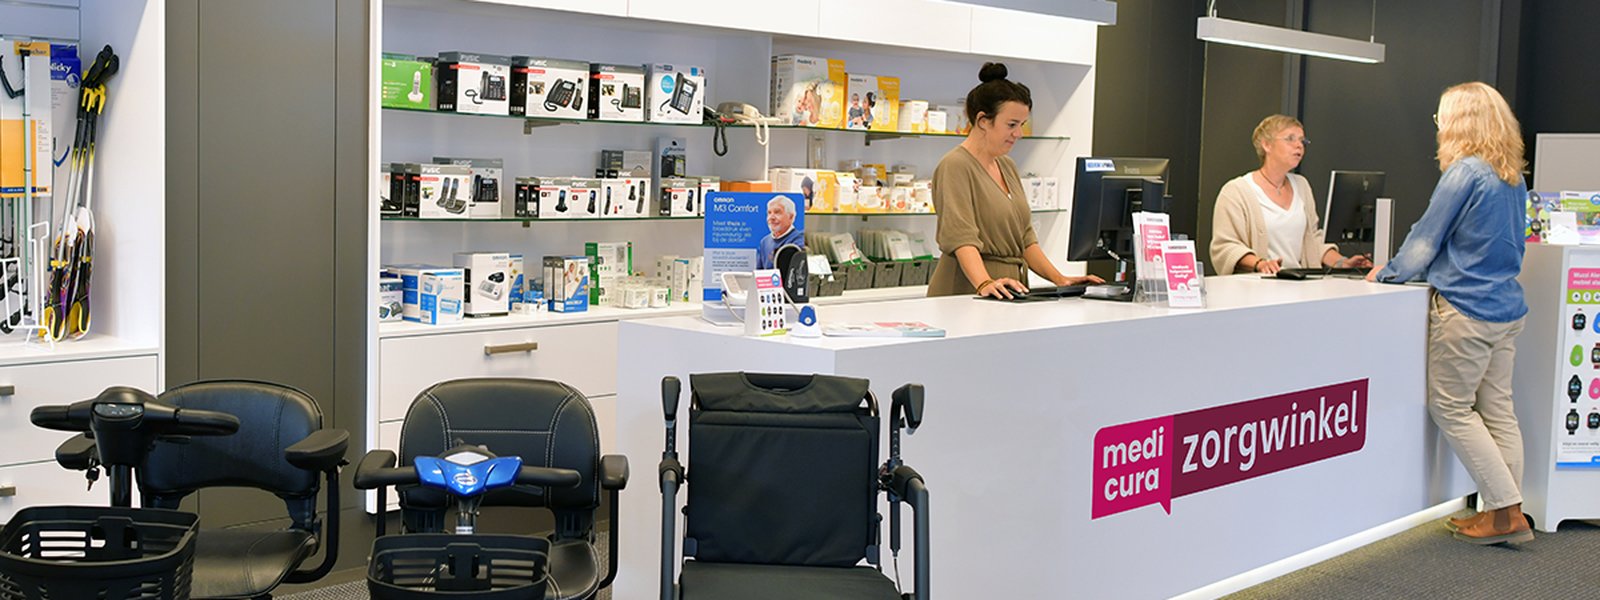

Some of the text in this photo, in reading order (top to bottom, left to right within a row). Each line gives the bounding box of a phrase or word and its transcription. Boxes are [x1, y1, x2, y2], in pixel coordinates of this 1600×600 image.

[713, 204, 759, 213] M3 Comfort
[1102, 389, 1359, 474] medi zorgwinkel
[1103, 467, 1160, 502] cura
